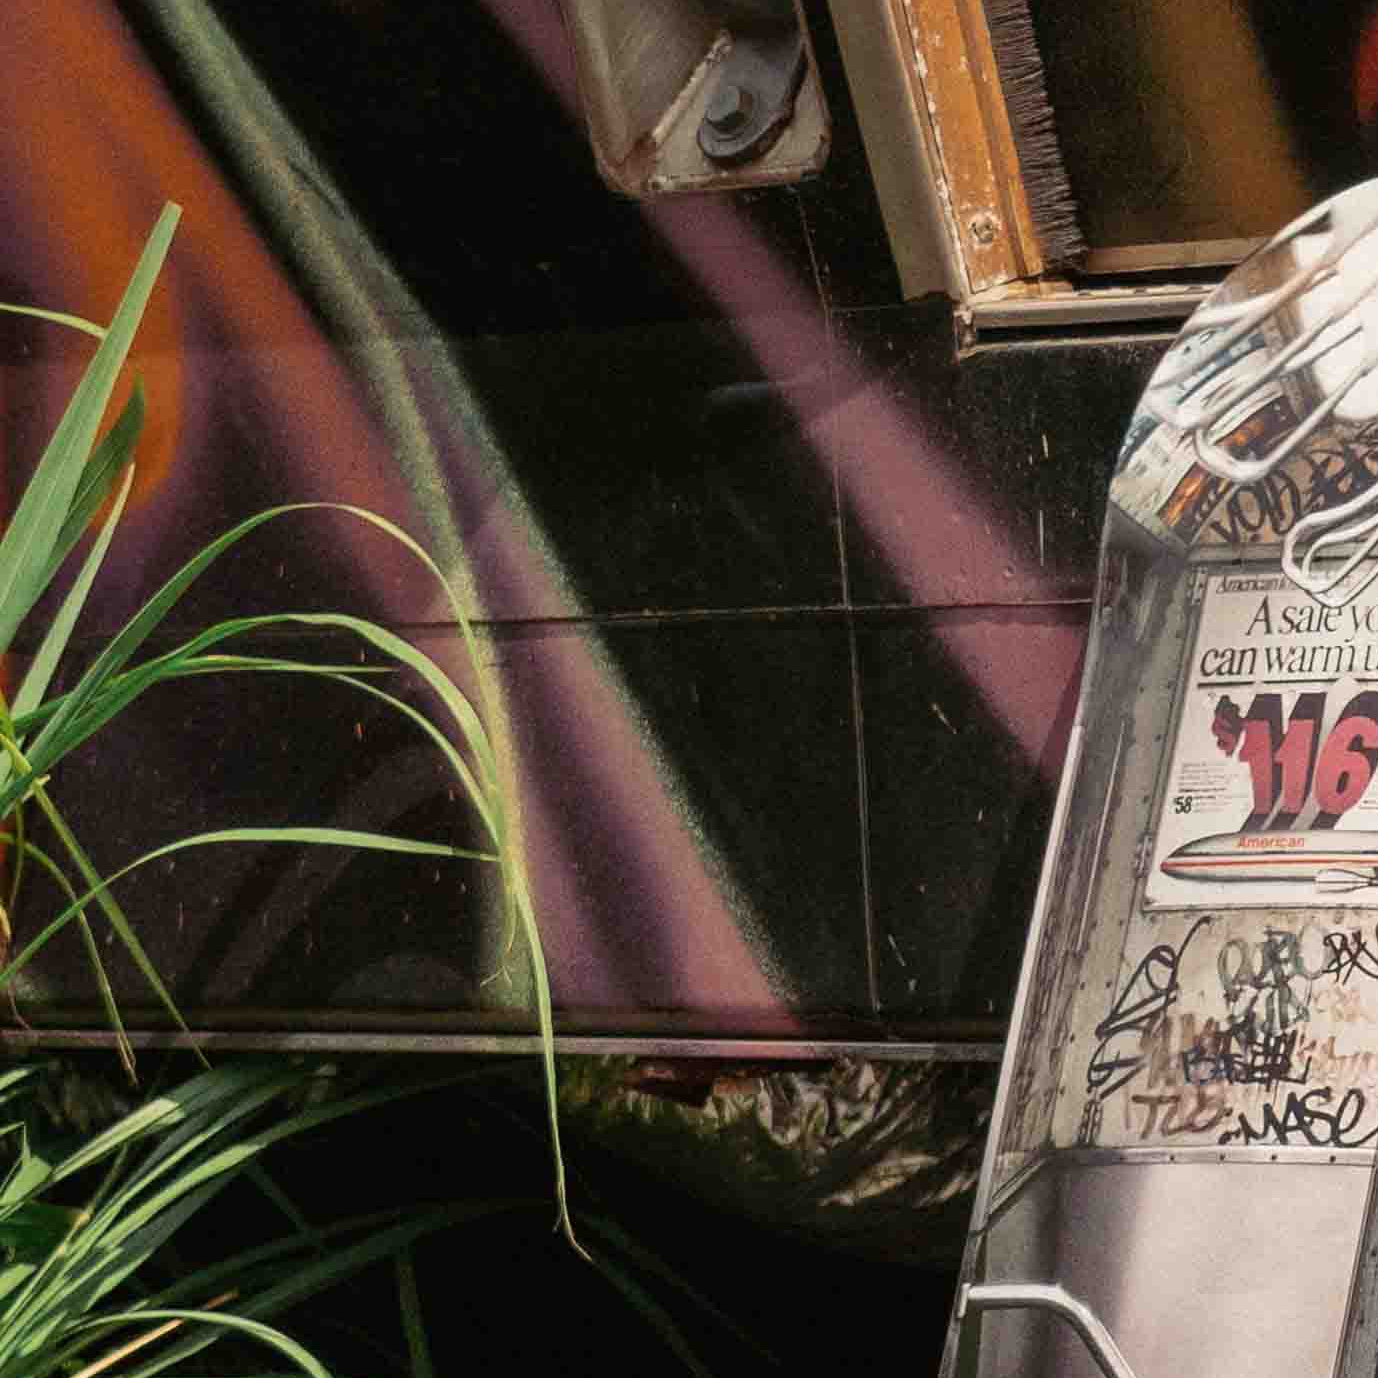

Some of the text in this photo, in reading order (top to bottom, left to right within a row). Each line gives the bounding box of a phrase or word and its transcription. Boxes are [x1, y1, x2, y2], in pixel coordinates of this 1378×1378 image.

[1245, 594, 1273, 636] A
[1200, 645, 1258, 677] can
[1264, 641, 1356, 674] warm
[1235, 834, 1306, 850] American
